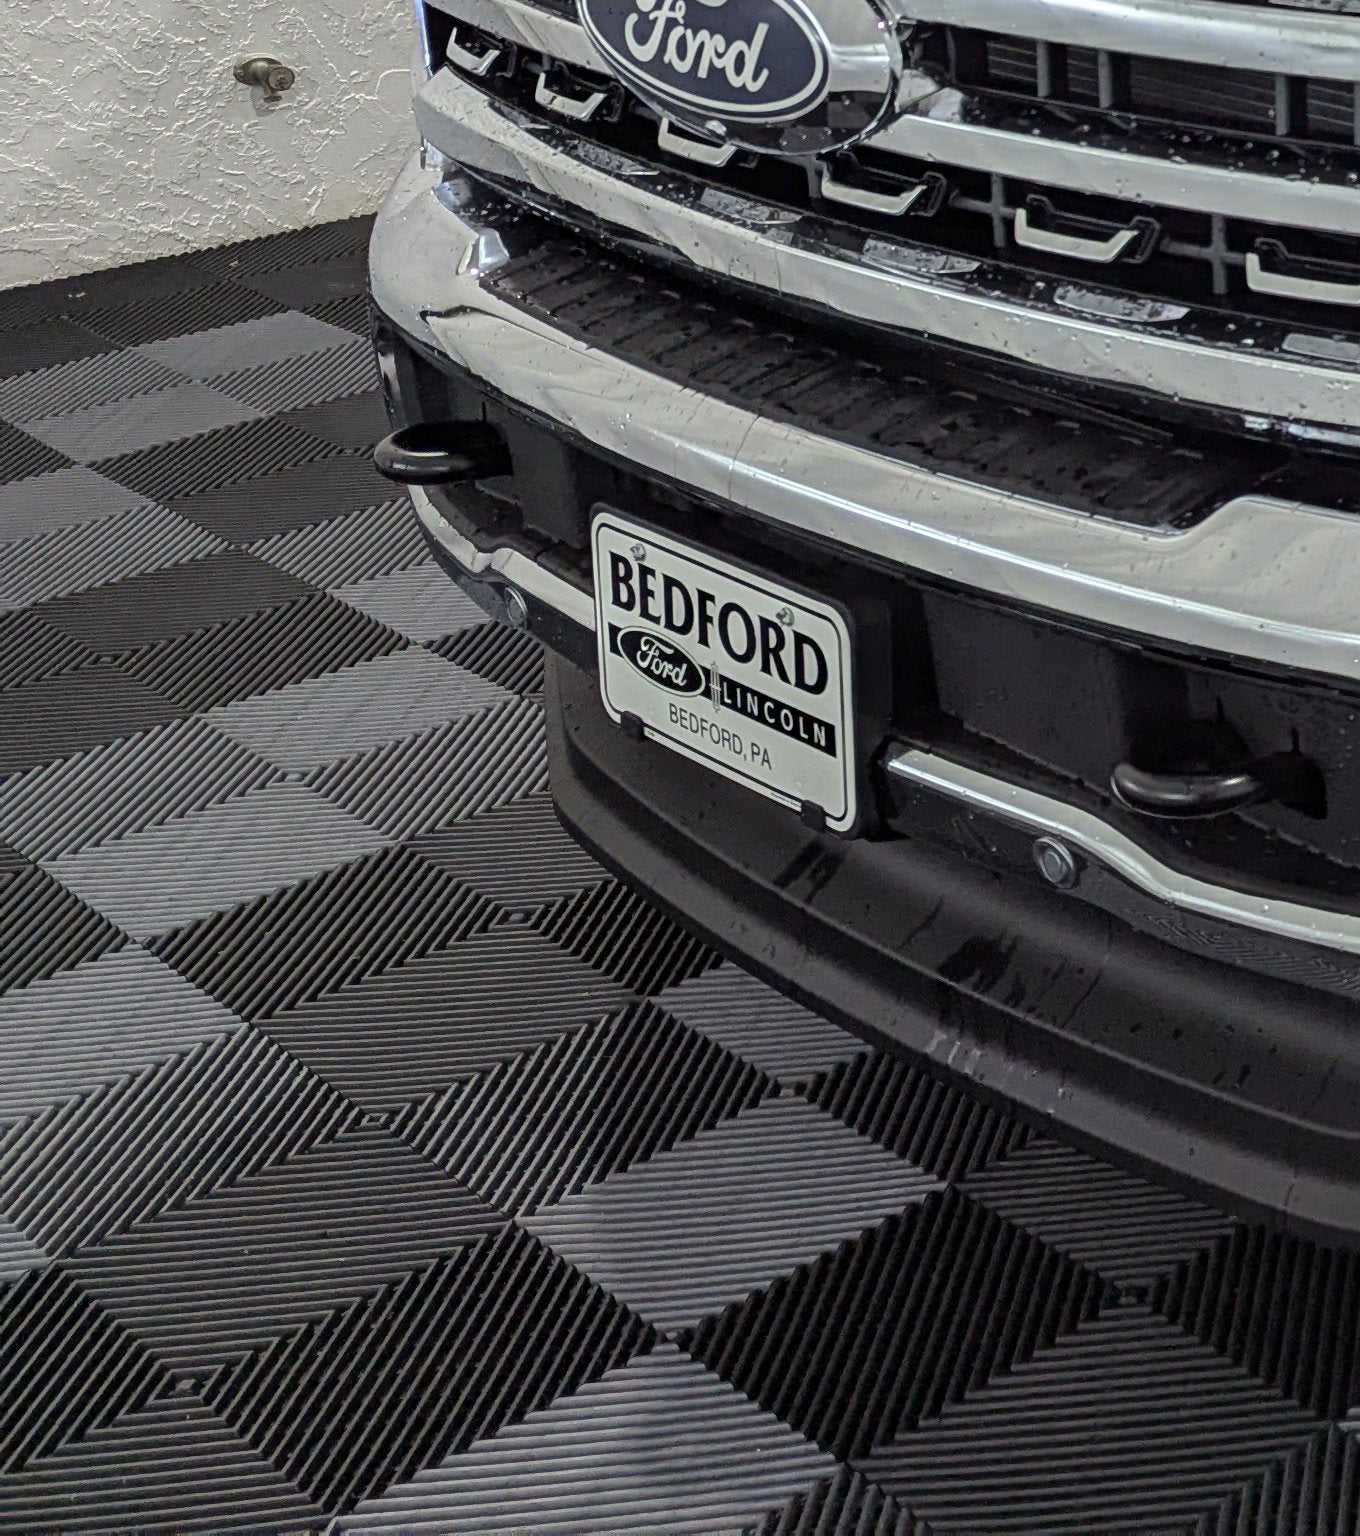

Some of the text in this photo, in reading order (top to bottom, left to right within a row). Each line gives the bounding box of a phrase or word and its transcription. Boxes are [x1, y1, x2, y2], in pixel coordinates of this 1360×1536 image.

[608, 550, 829, 696] BEDFORD
[636, 633, 828, 748] Ford LINCOLN
[668, 702, 773, 771] BEDFORD, PA
